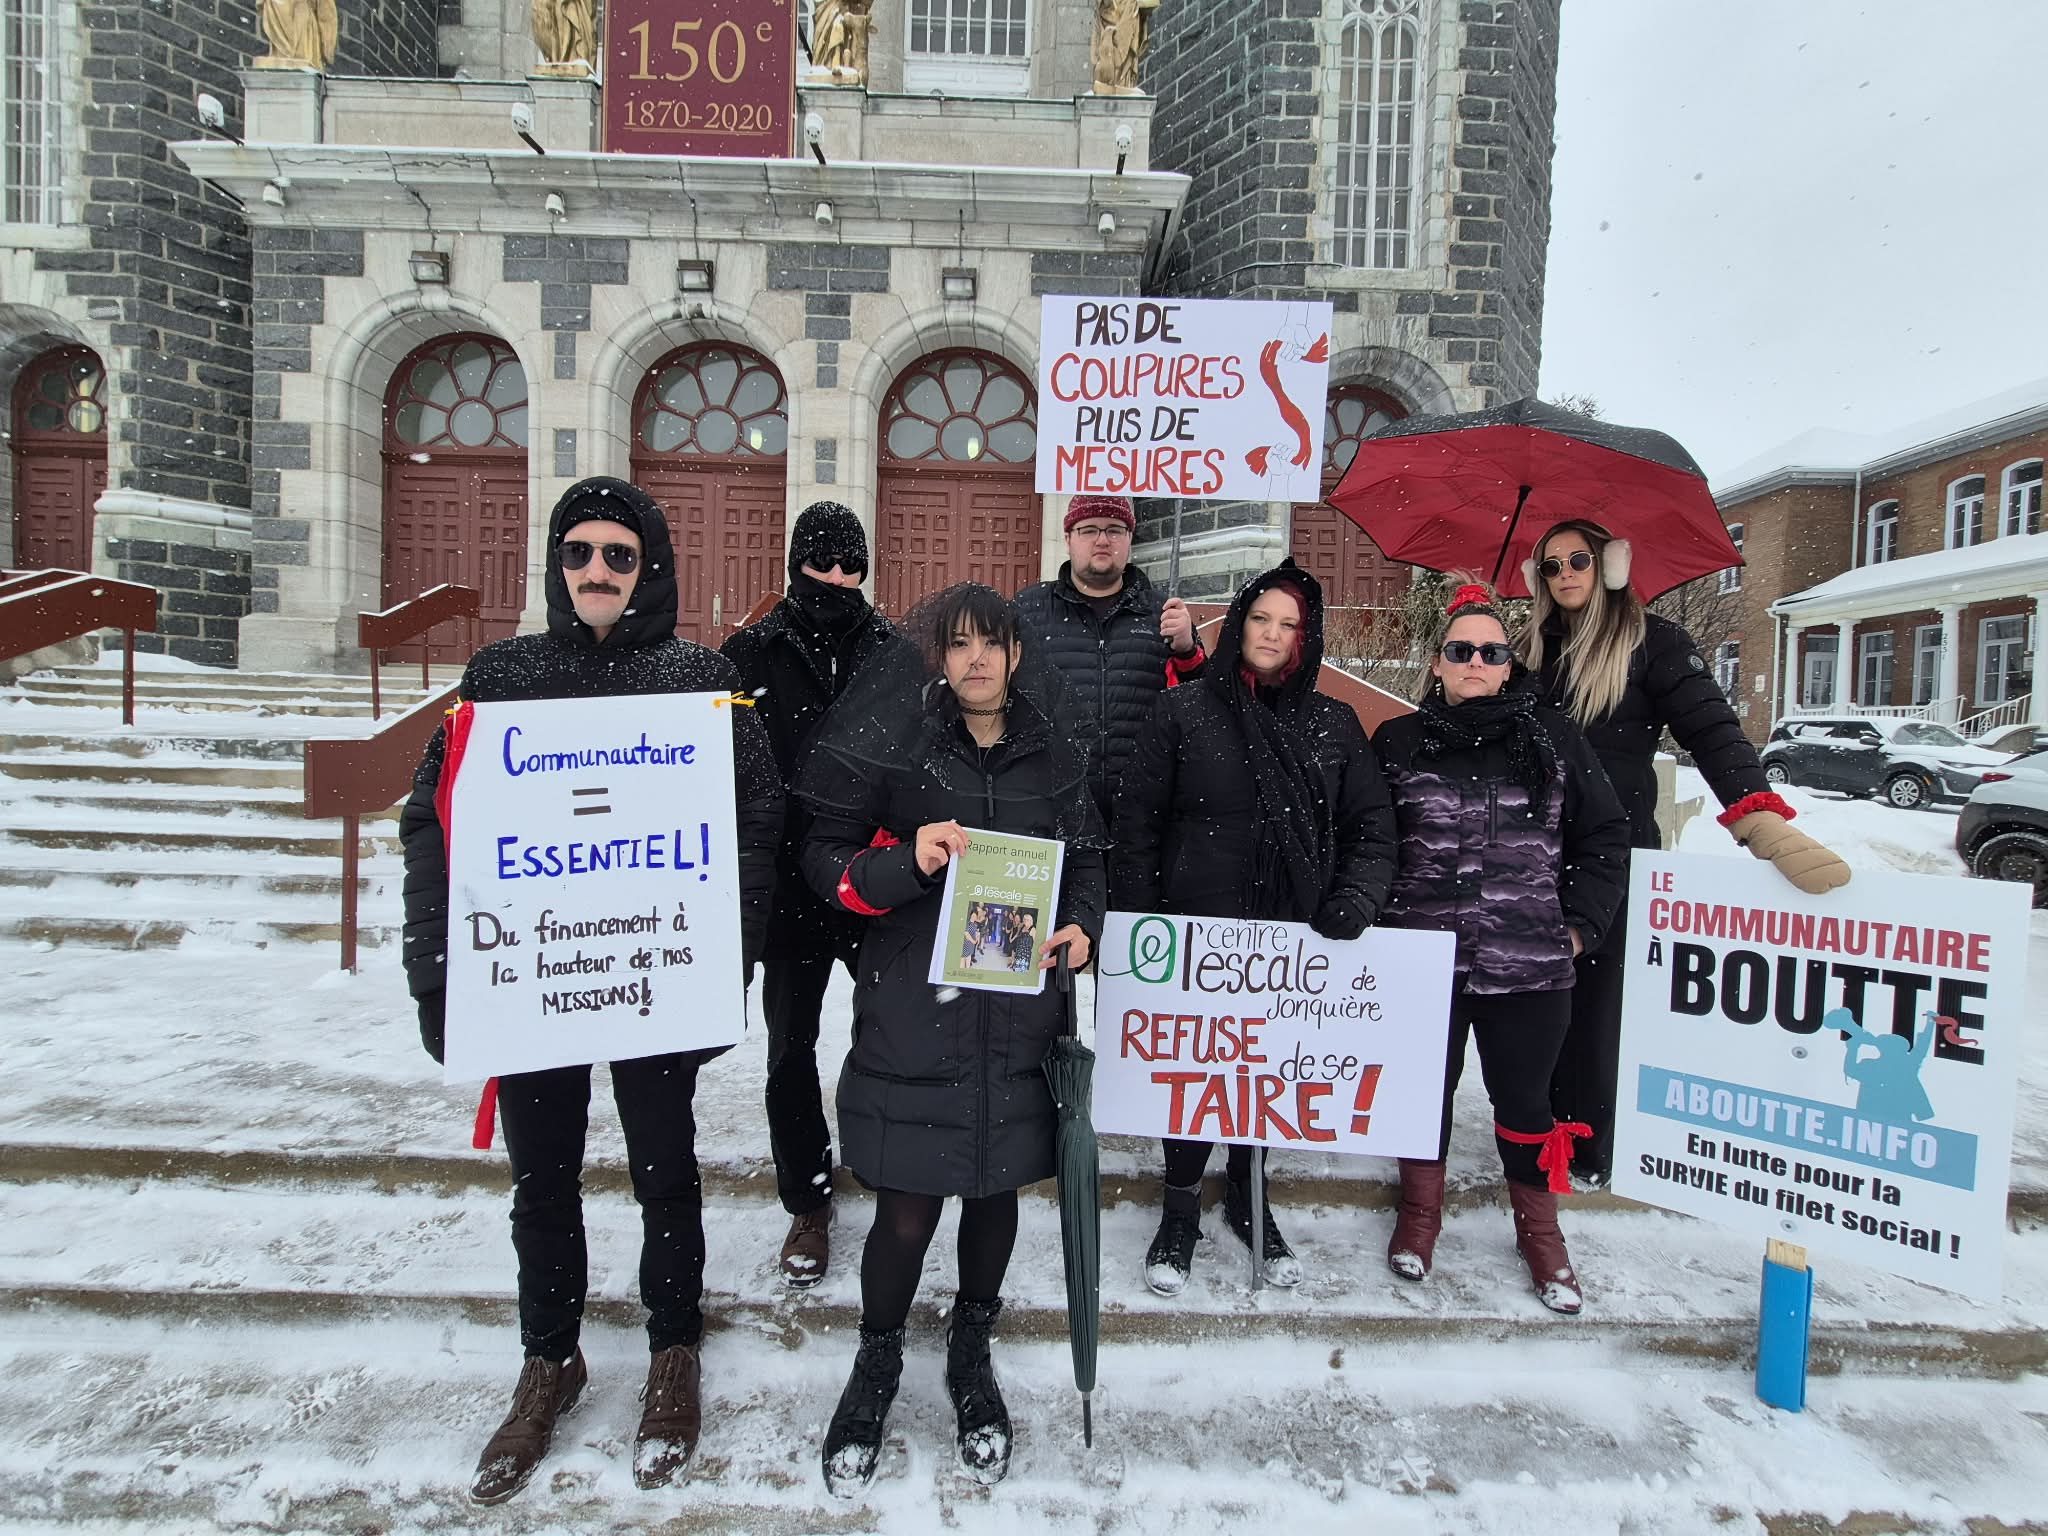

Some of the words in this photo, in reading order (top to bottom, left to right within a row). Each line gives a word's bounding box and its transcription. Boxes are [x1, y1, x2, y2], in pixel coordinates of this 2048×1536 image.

[1075, 302, 1129, 347] PAS
[1134, 302, 1182, 344] DE
[1050, 352, 1245, 402] COUPURES
[1075, 406, 1142, 443] PLUS
[1150, 406, 1199, 441] DE
[1055, 445, 1225, 495] MESURES
[502, 726, 696, 777] Communautaire
[497, 823, 710, 882] ESSENTIEL!
[964, 839, 1008, 855] Rapport
[1010, 848, 1048, 861] annuel
[1004, 861, 1050, 882] 2025
[1651, 871, 1674, 893] LE
[472, 911, 521, 951] Du
[534, 905, 662, 944] financement
[672, 901, 689, 932] à
[1206, 922, 1288, 951] centre
[1649, 898, 1991, 972] COMMUNAUTAIRE
[491, 961, 518, 986] la
[536, 950, 616, 979] hauteur
[629, 947, 653, 971] de
[662, 946, 693, 967] nos
[1352, 965, 1377, 991] de
[1266, 993, 1383, 1029] Jonquière
[1647, 935, 1663, 966] À
[1670, 942, 1988, 1065] BOUTTE
[1120, 1009, 1267, 1063] REFUSE
[1280, 1042, 1315, 1082] de
[1322, 1054, 1358, 1081] se
[1665, 1078, 1938, 1169] ABOUTTE.INFO
[1687, 1133, 1716, 1159] En
[1723, 1141, 1787, 1177] lutte
[1794, 1161, 1865, 1197] pour
[1871, 1177, 1901, 1207] la
[1639, 1153, 1728, 1196] SURVIE
[1734, 1179, 1769, 1206] du
[1775, 1189, 1835, 1225] filet
[1841, 1208, 1941, 1254] social
